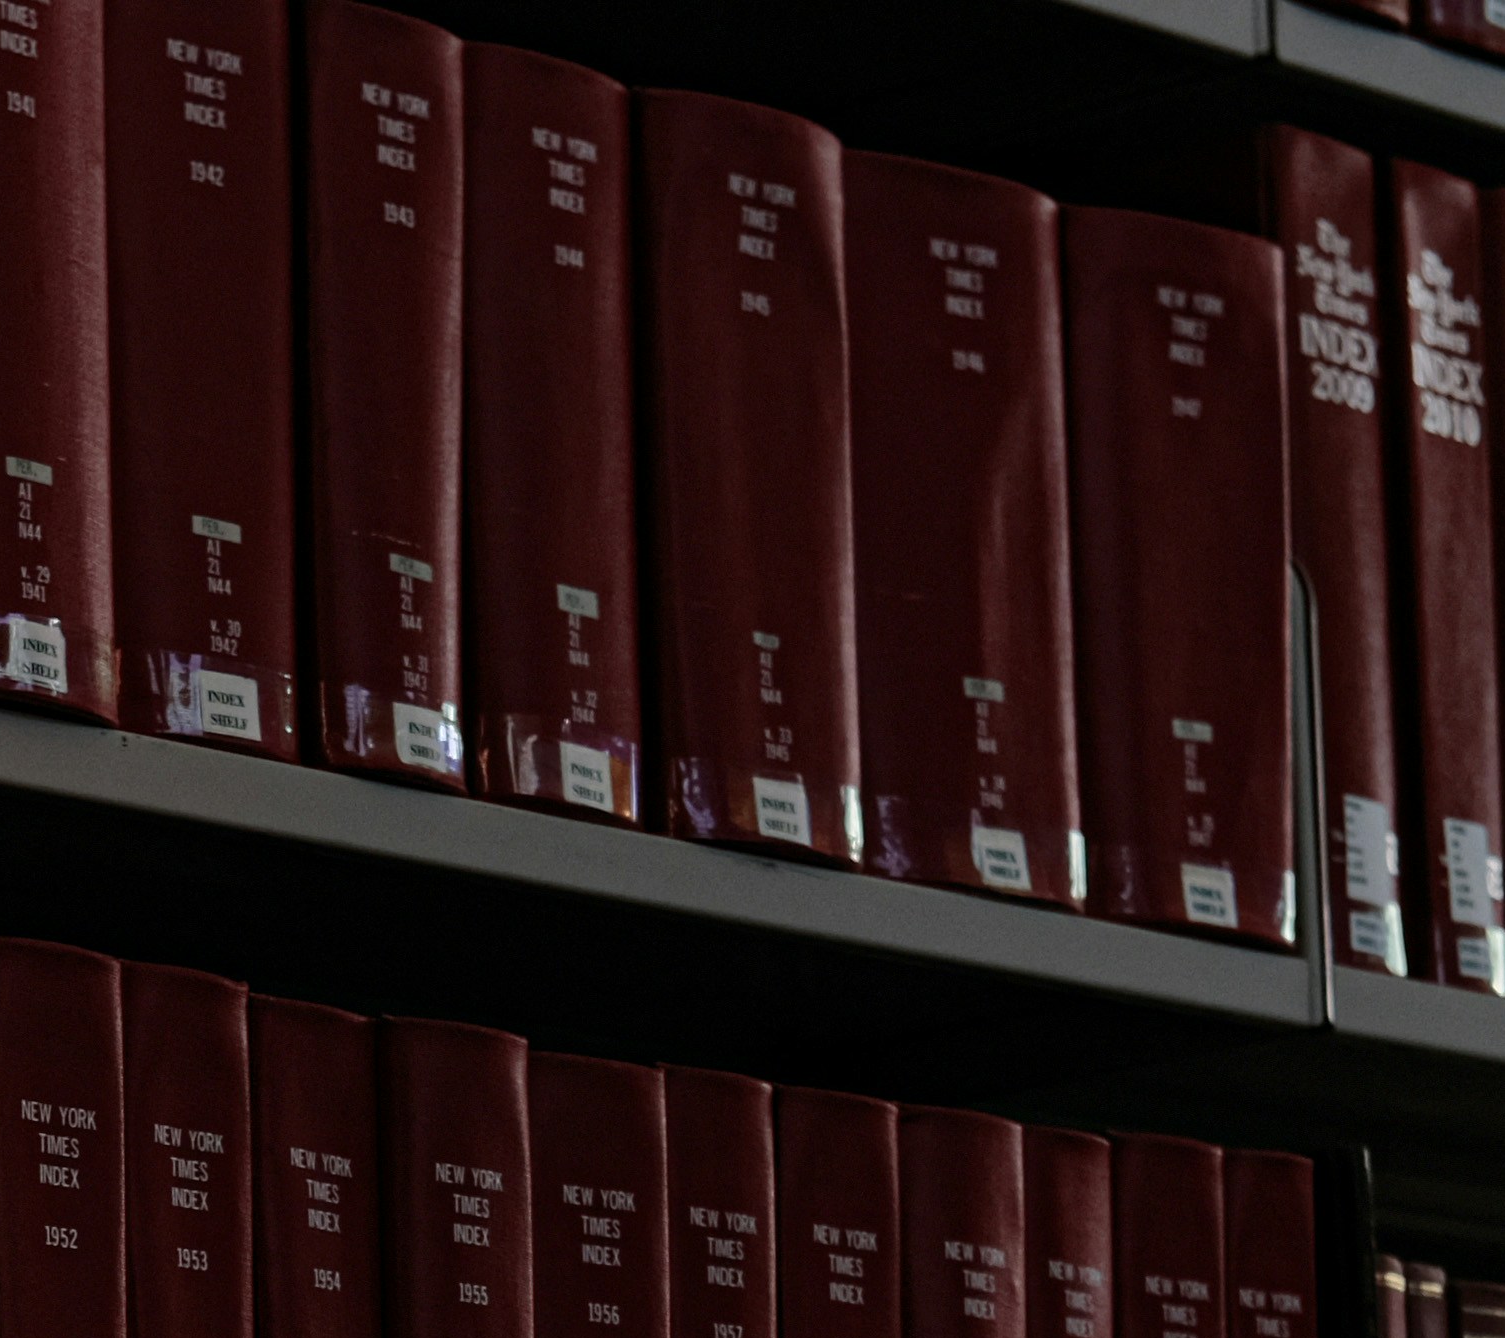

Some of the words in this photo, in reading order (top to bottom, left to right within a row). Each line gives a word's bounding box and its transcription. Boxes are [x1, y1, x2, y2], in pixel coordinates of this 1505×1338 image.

[167, 38, 198, 63] NEW
[204, 47, 244, 76] YORK
[183, 71, 226, 101] TIMES
[184, 102, 226, 129] INDEX
[436, 1163, 465, 1184] NEW
[470, 1167, 504, 1192] YORK
[453, 1193, 490, 1219] TIMES
[454, 1223, 489, 1247] INDEX
[459, 1282, 488, 1305] 1955
